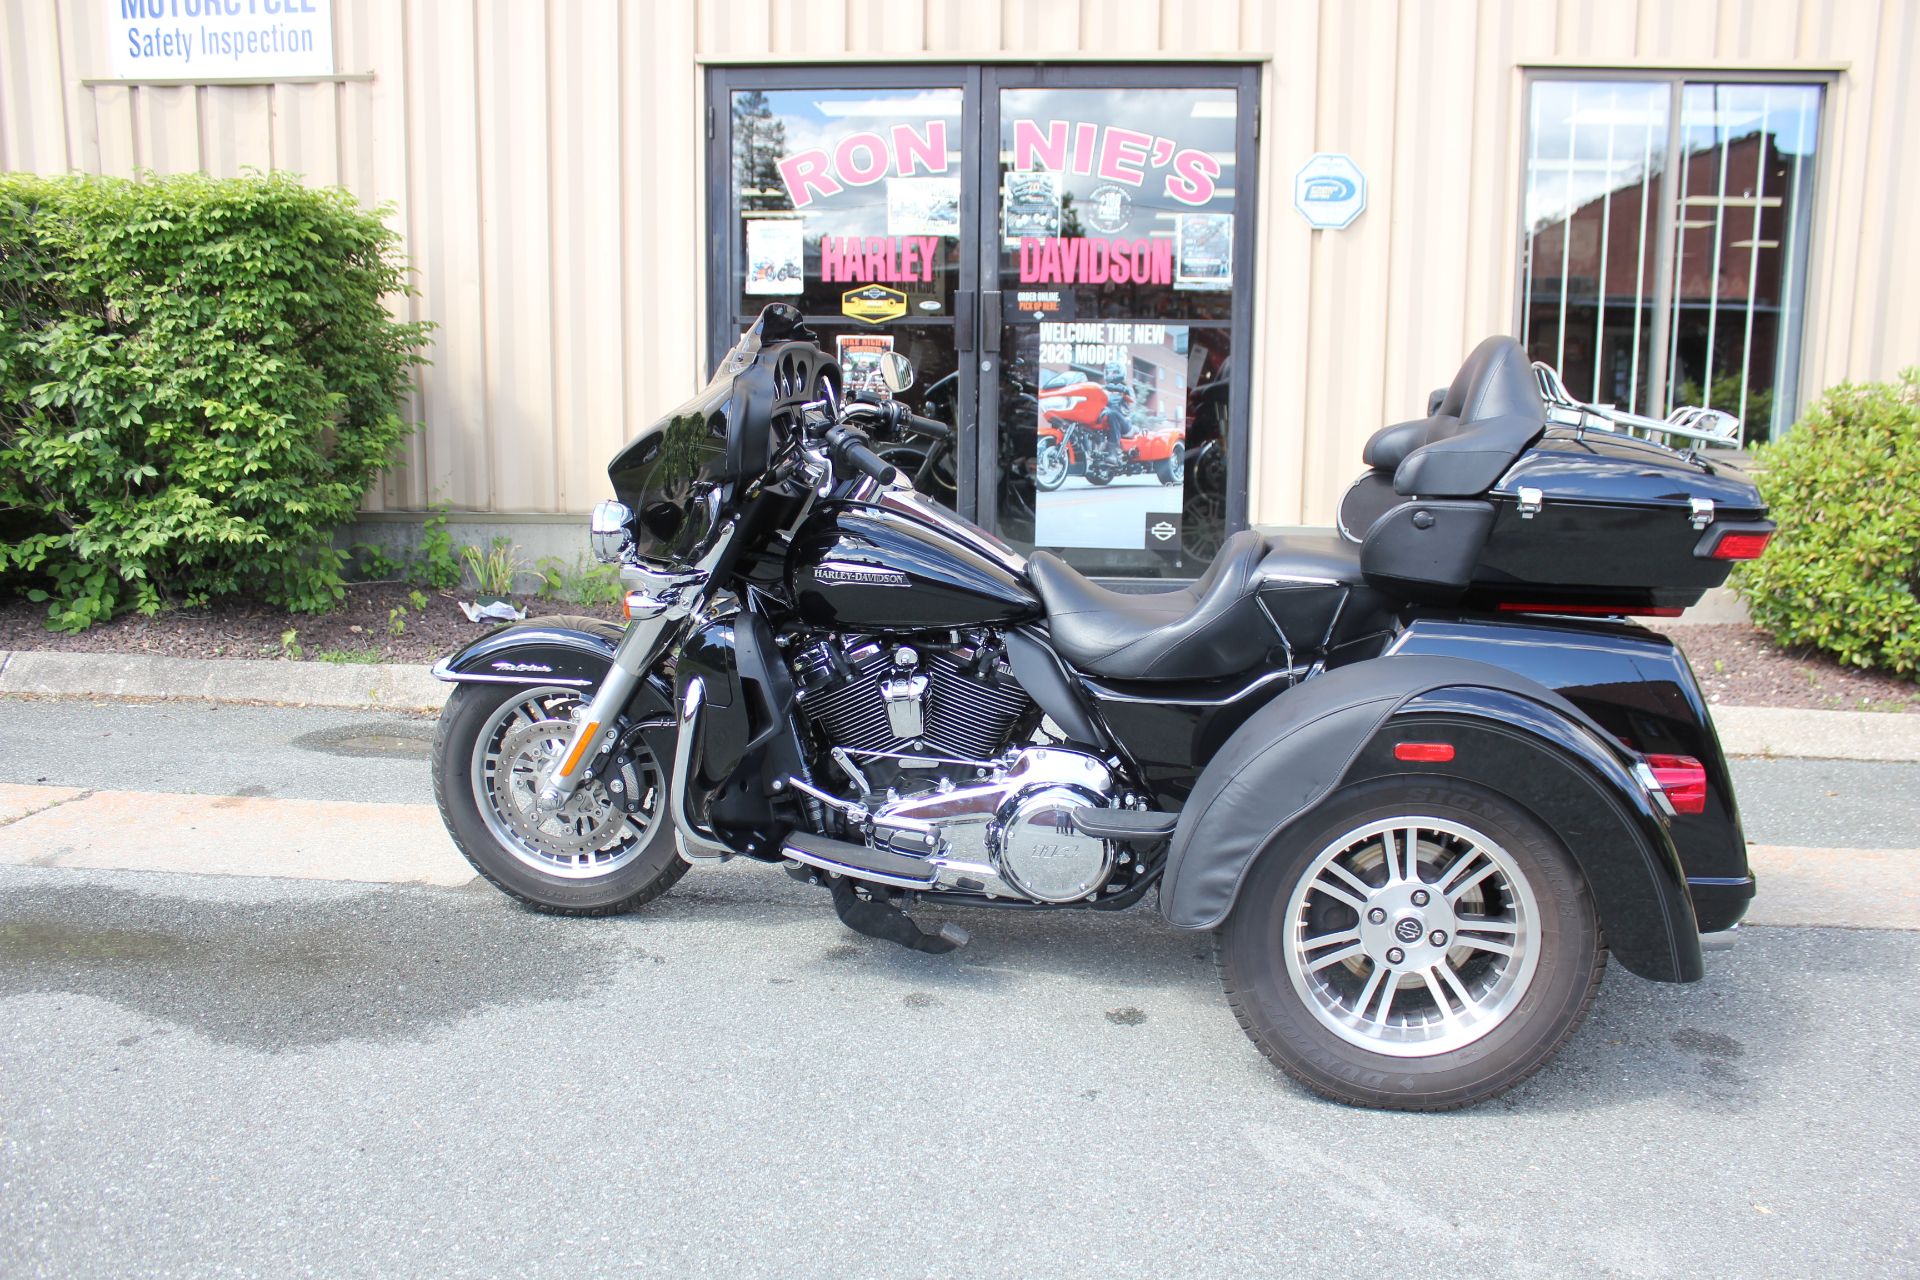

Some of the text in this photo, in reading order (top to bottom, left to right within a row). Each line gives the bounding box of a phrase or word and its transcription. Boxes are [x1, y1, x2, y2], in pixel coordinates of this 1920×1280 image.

[128, 24, 313, 63] Safety Inspection
[776, 119, 1222, 209] RON NIE'S
[820, 236, 940, 283] HARLEY
[1019, 237, 1173, 285] DAVIDSON
[1017, 292, 1061, 301] ORDER ONLINE.
[1019, 302, 1033, 310] PICK
[1039, 322, 1166, 344] WELCOME THE NEW
[1039, 344, 1132, 364] 2026 MODELS.
[814, 569, 903, 584] HARLEY-DAVIDSON
[1031, 844, 1080, 859] 114
